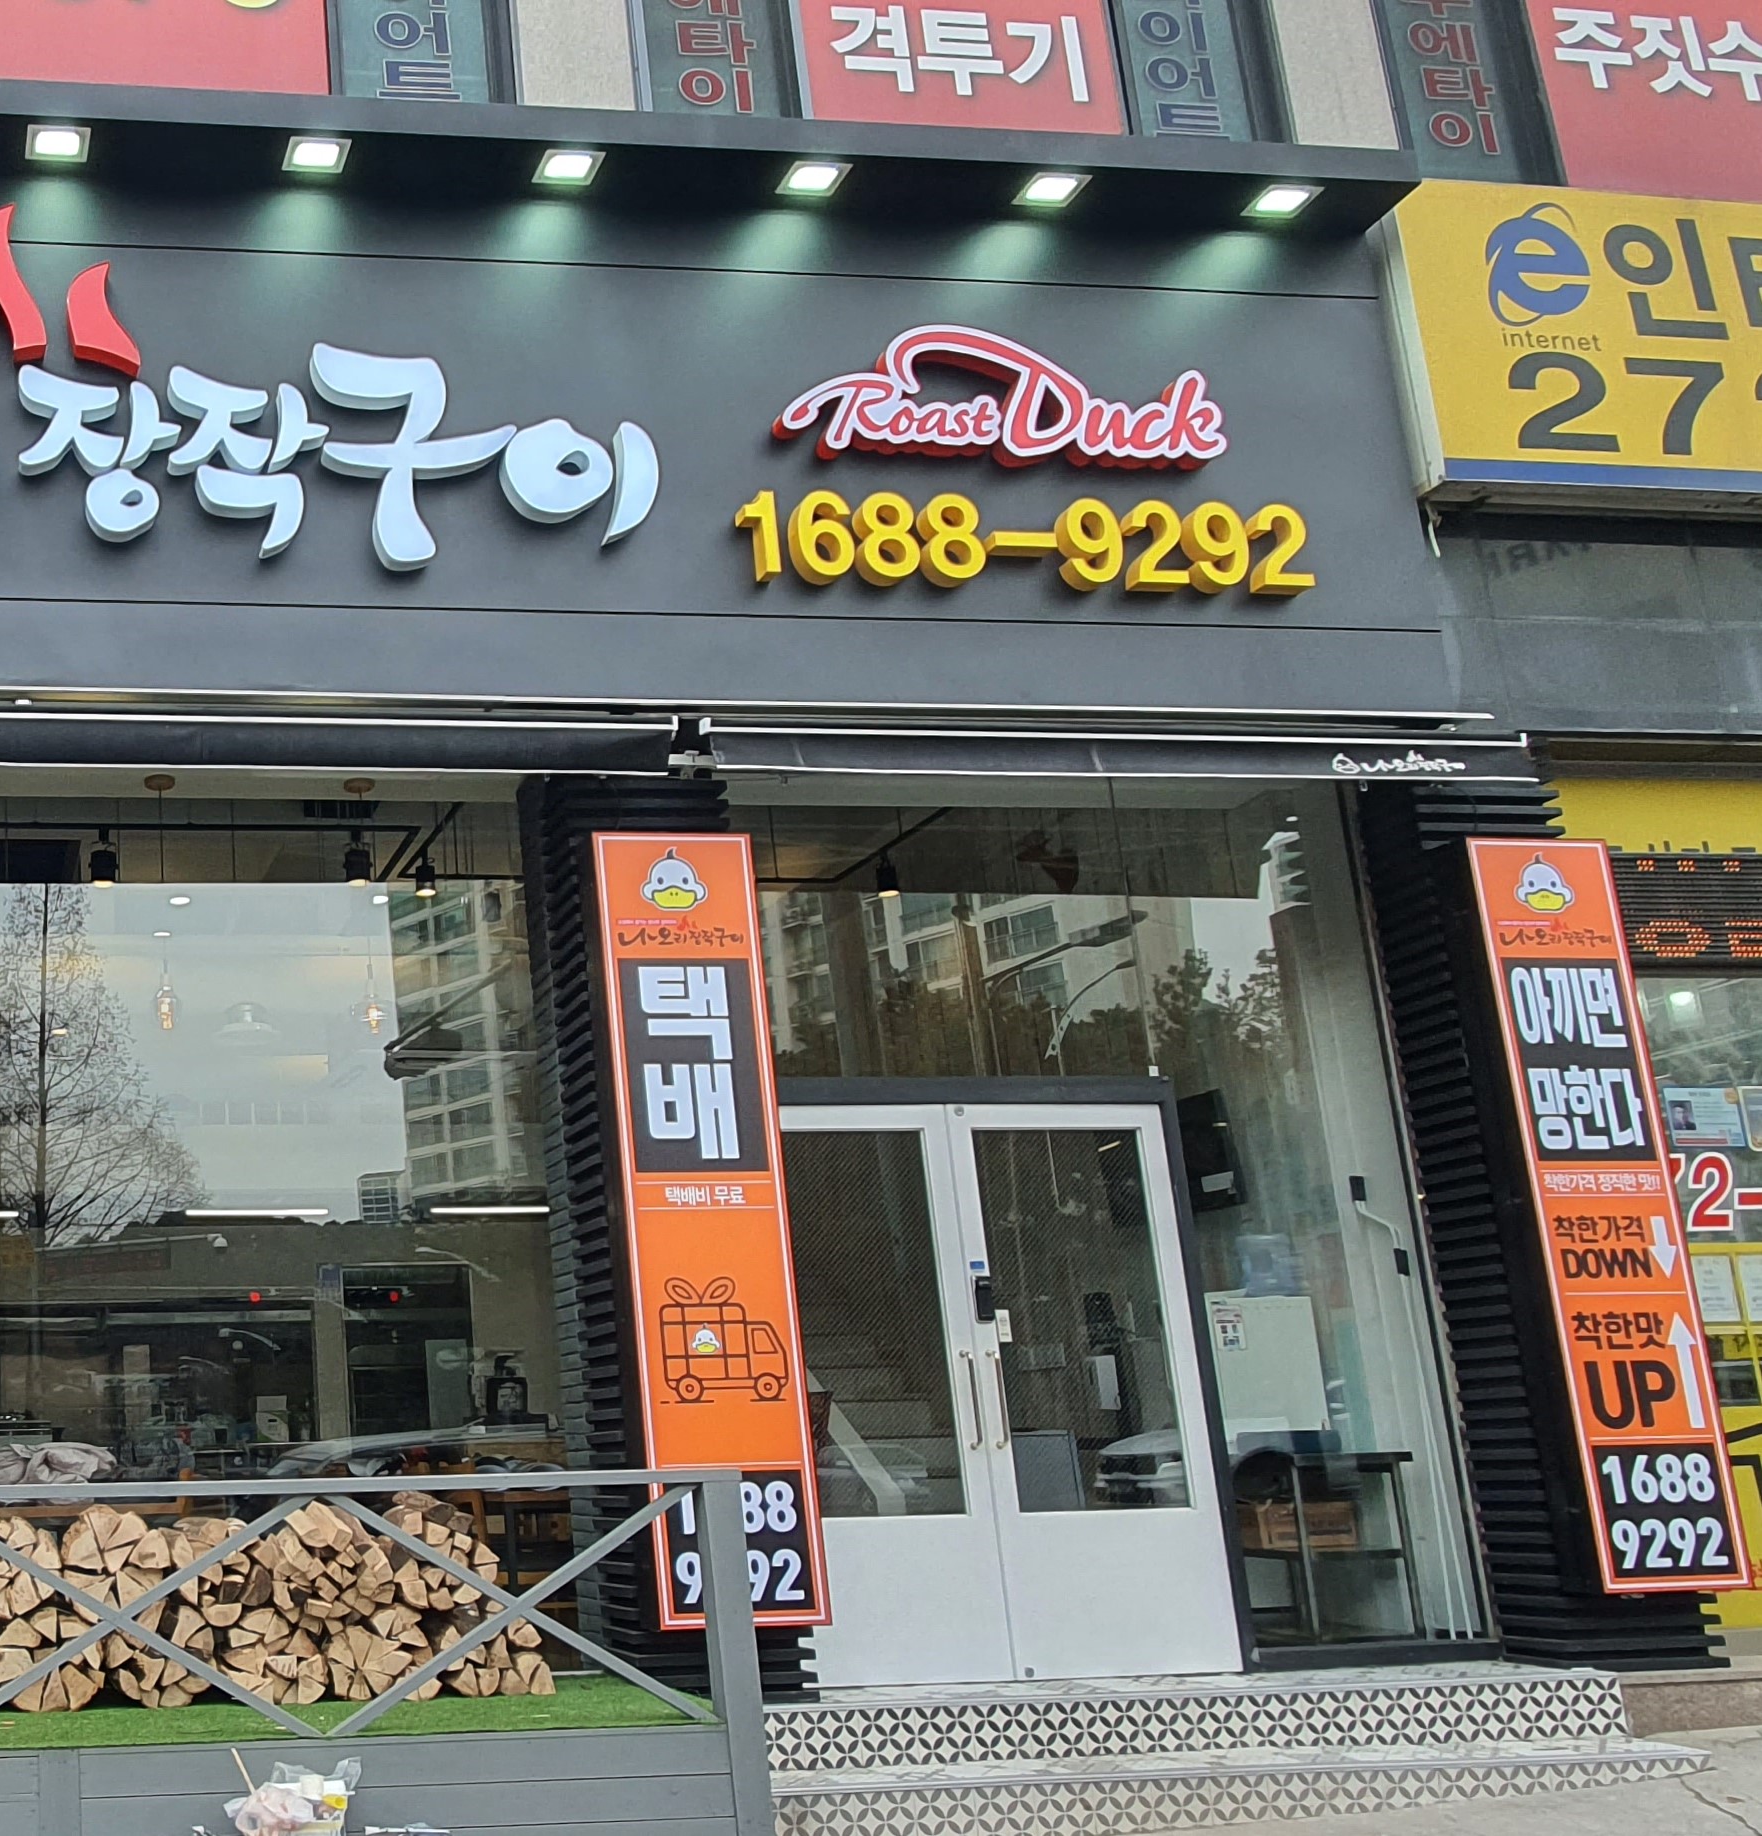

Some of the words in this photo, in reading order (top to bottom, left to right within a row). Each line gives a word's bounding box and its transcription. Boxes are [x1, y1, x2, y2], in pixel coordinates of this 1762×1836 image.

[374, 0, 462, 102] 어트
[830, 5, 1090, 103] 격투기
[1138, 0, 1230, 138] 이어트
[1552, 7, 1762, 102] 주짓수
[1501, 327, 1602, 352] internet
[773, 371, 1001, 460] Roast
[886, 323, 1228, 468] Duck
[1508, 351, 1762, 456] 27
[734, 489, 1316, 596] 1688-9292
[1510, 966, 1628, 1048] 아끼면
[638, 965, 740, 1160] 택배
[1527, 1064, 1646, 1150] 망한다
[665, 1186, 711, 1206] 택배비
[714, 1186, 746, 1205] 무료
[1552, 1215, 1645, 1243] 착한가격
[1560, 1247, 1653, 1279] DOWN
[1571, 1311, 1667, 1350] 착한맛
[1584, 1360, 1676, 1430] UP
[680, 1480, 797, 1536] 188
[1602, 1453, 1715, 1504] 1688
[676, 1549, 805, 1604] 992
[1611, 1516, 1729, 1569] 9292
